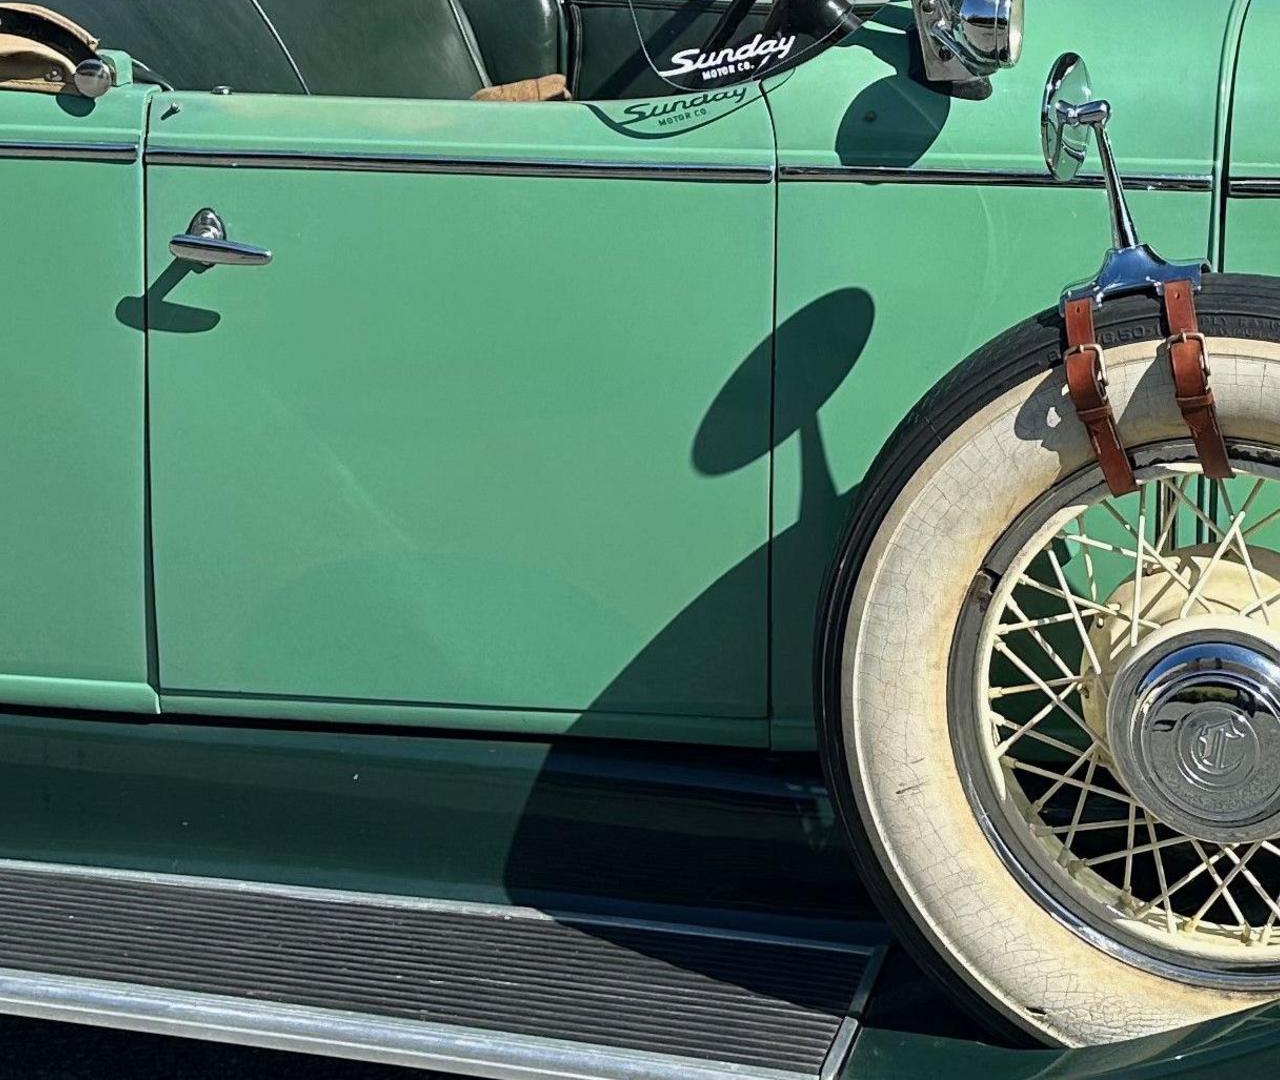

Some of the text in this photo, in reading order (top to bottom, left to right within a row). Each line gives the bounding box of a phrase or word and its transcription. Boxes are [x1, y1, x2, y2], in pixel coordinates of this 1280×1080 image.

[658, 33, 796, 77] Sunday
[702, 61, 755, 81] MOTOR CO.
[616, 87, 747, 126] Sunday
[658, 111, 692, 126] MOTOR
